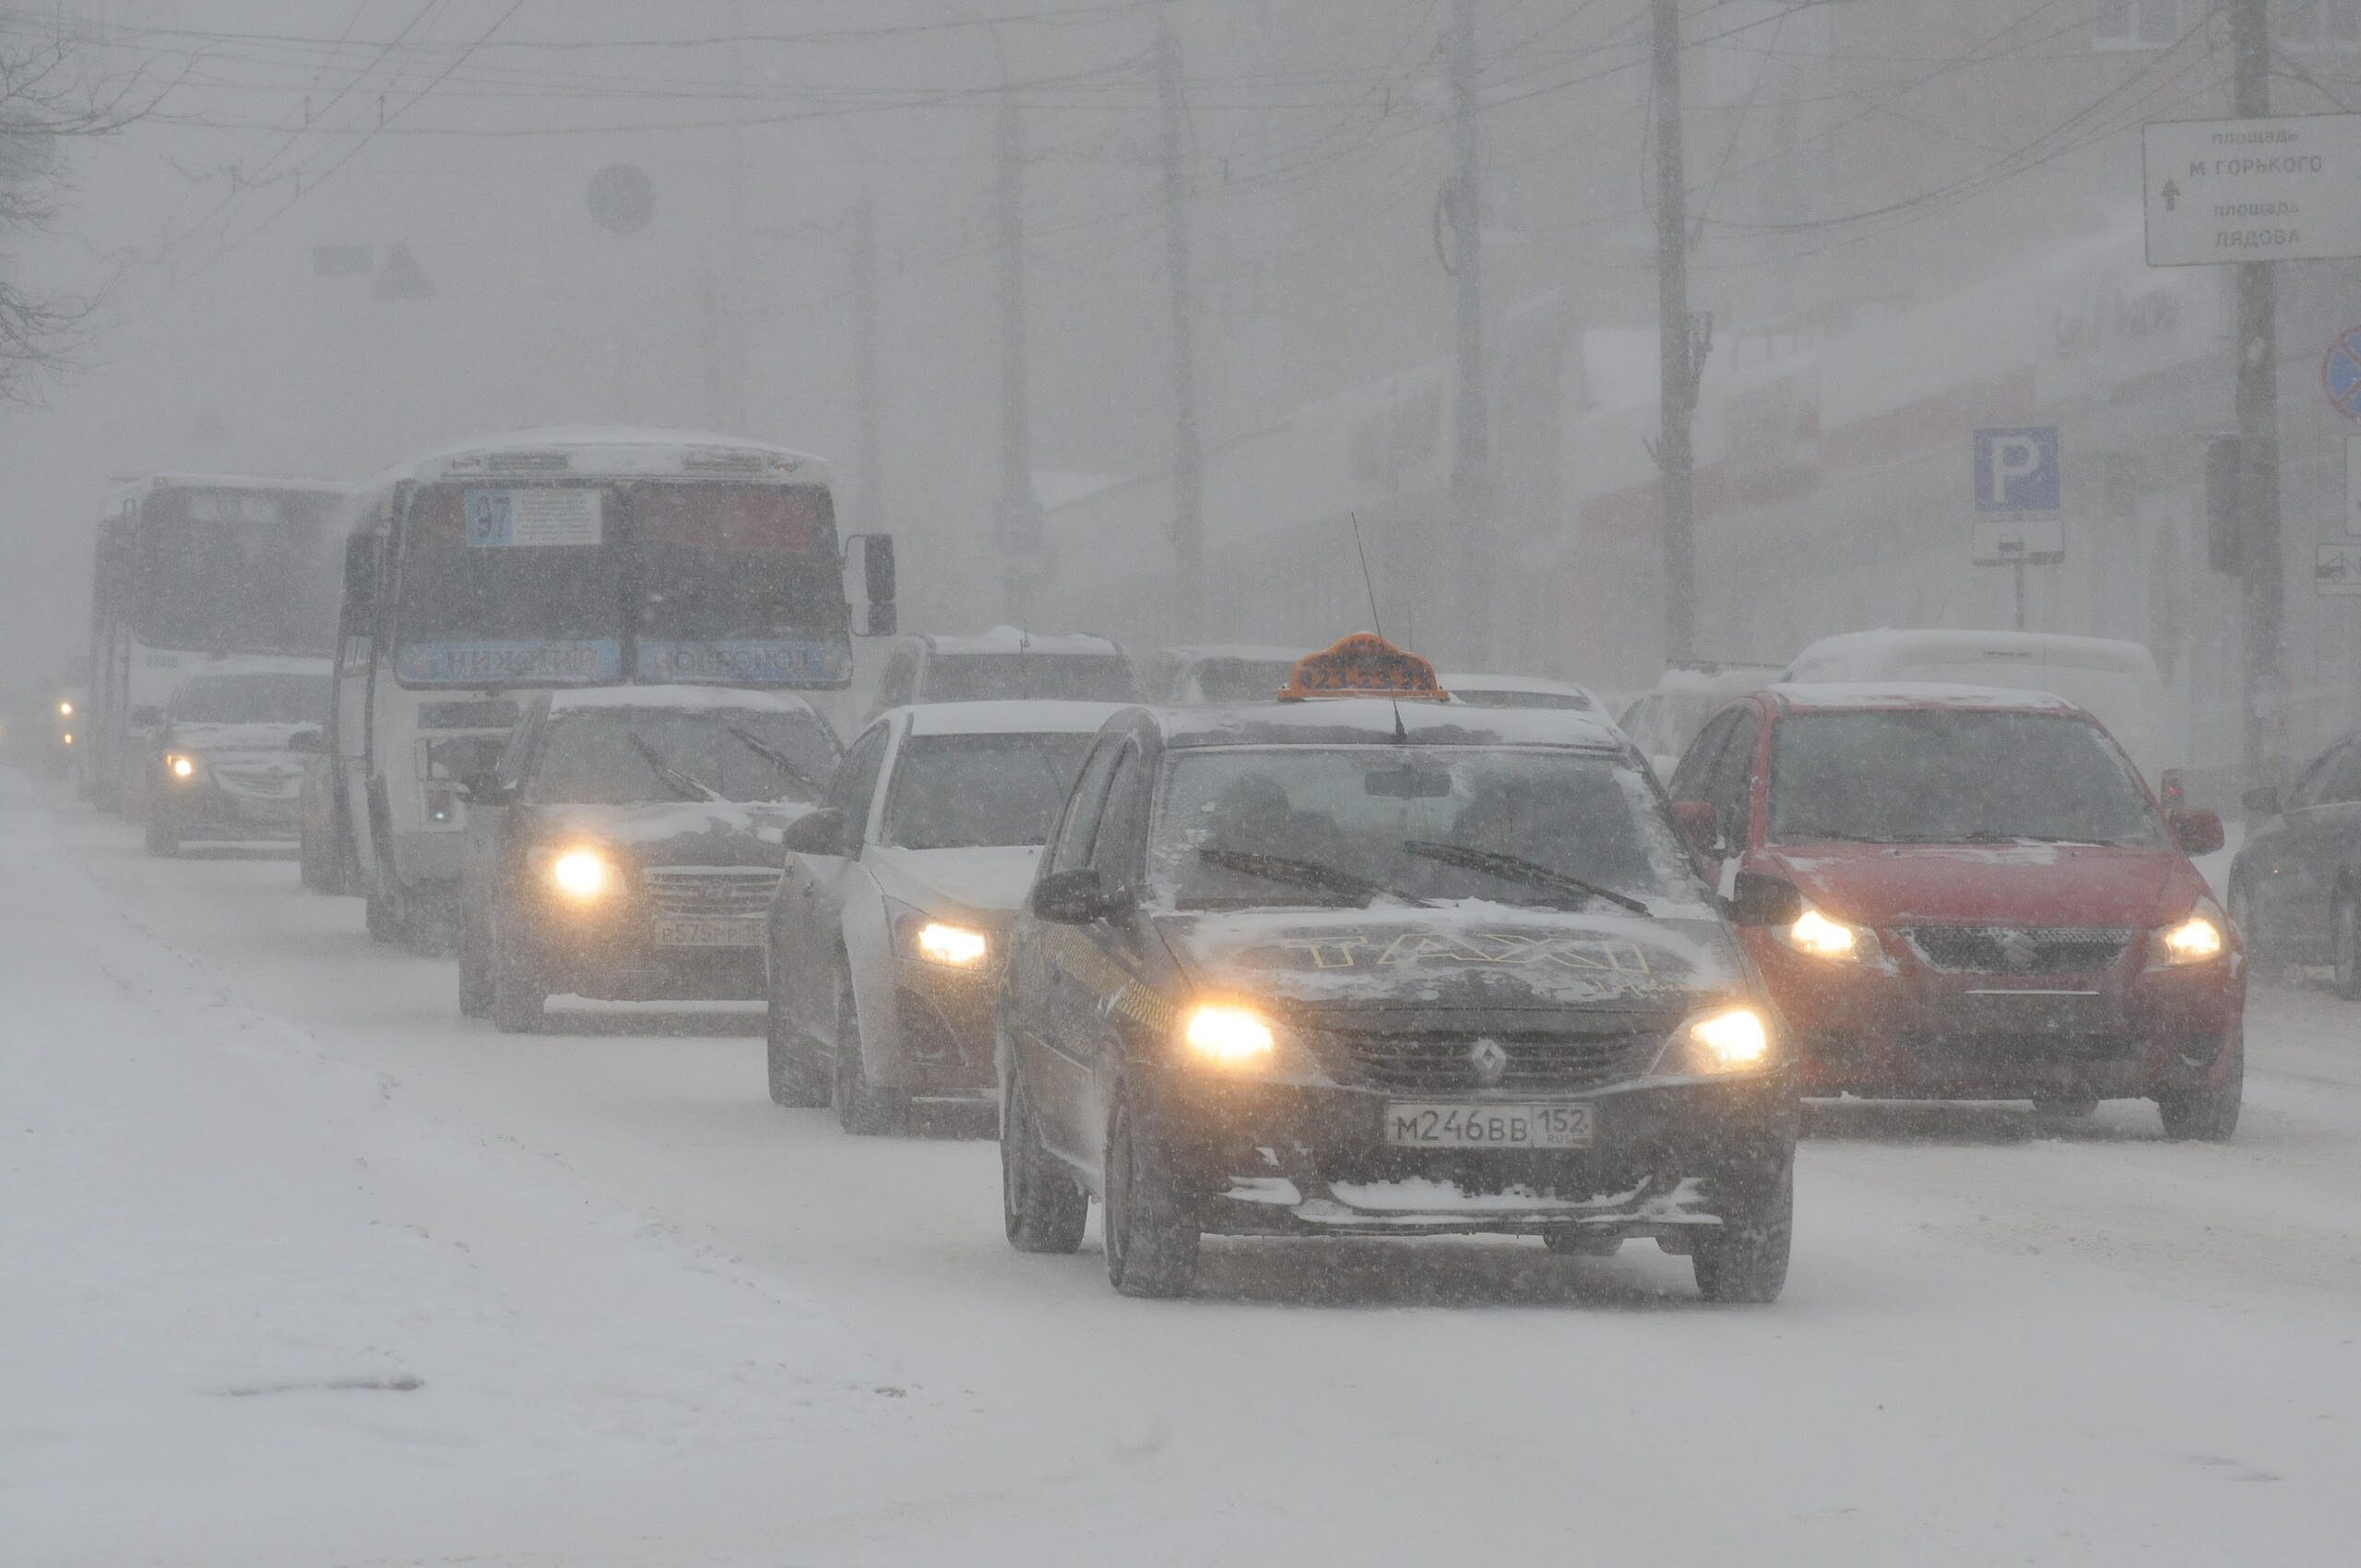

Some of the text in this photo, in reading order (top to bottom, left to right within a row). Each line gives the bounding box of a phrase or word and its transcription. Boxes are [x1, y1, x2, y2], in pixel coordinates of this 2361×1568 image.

[2215, 155, 2322, 175] ГОРЬКОГО
[2215, 229, 2300, 249] ЛЯДОВА
[477, 495, 509, 539] 97
[1537, 1109, 1584, 1133] 152
